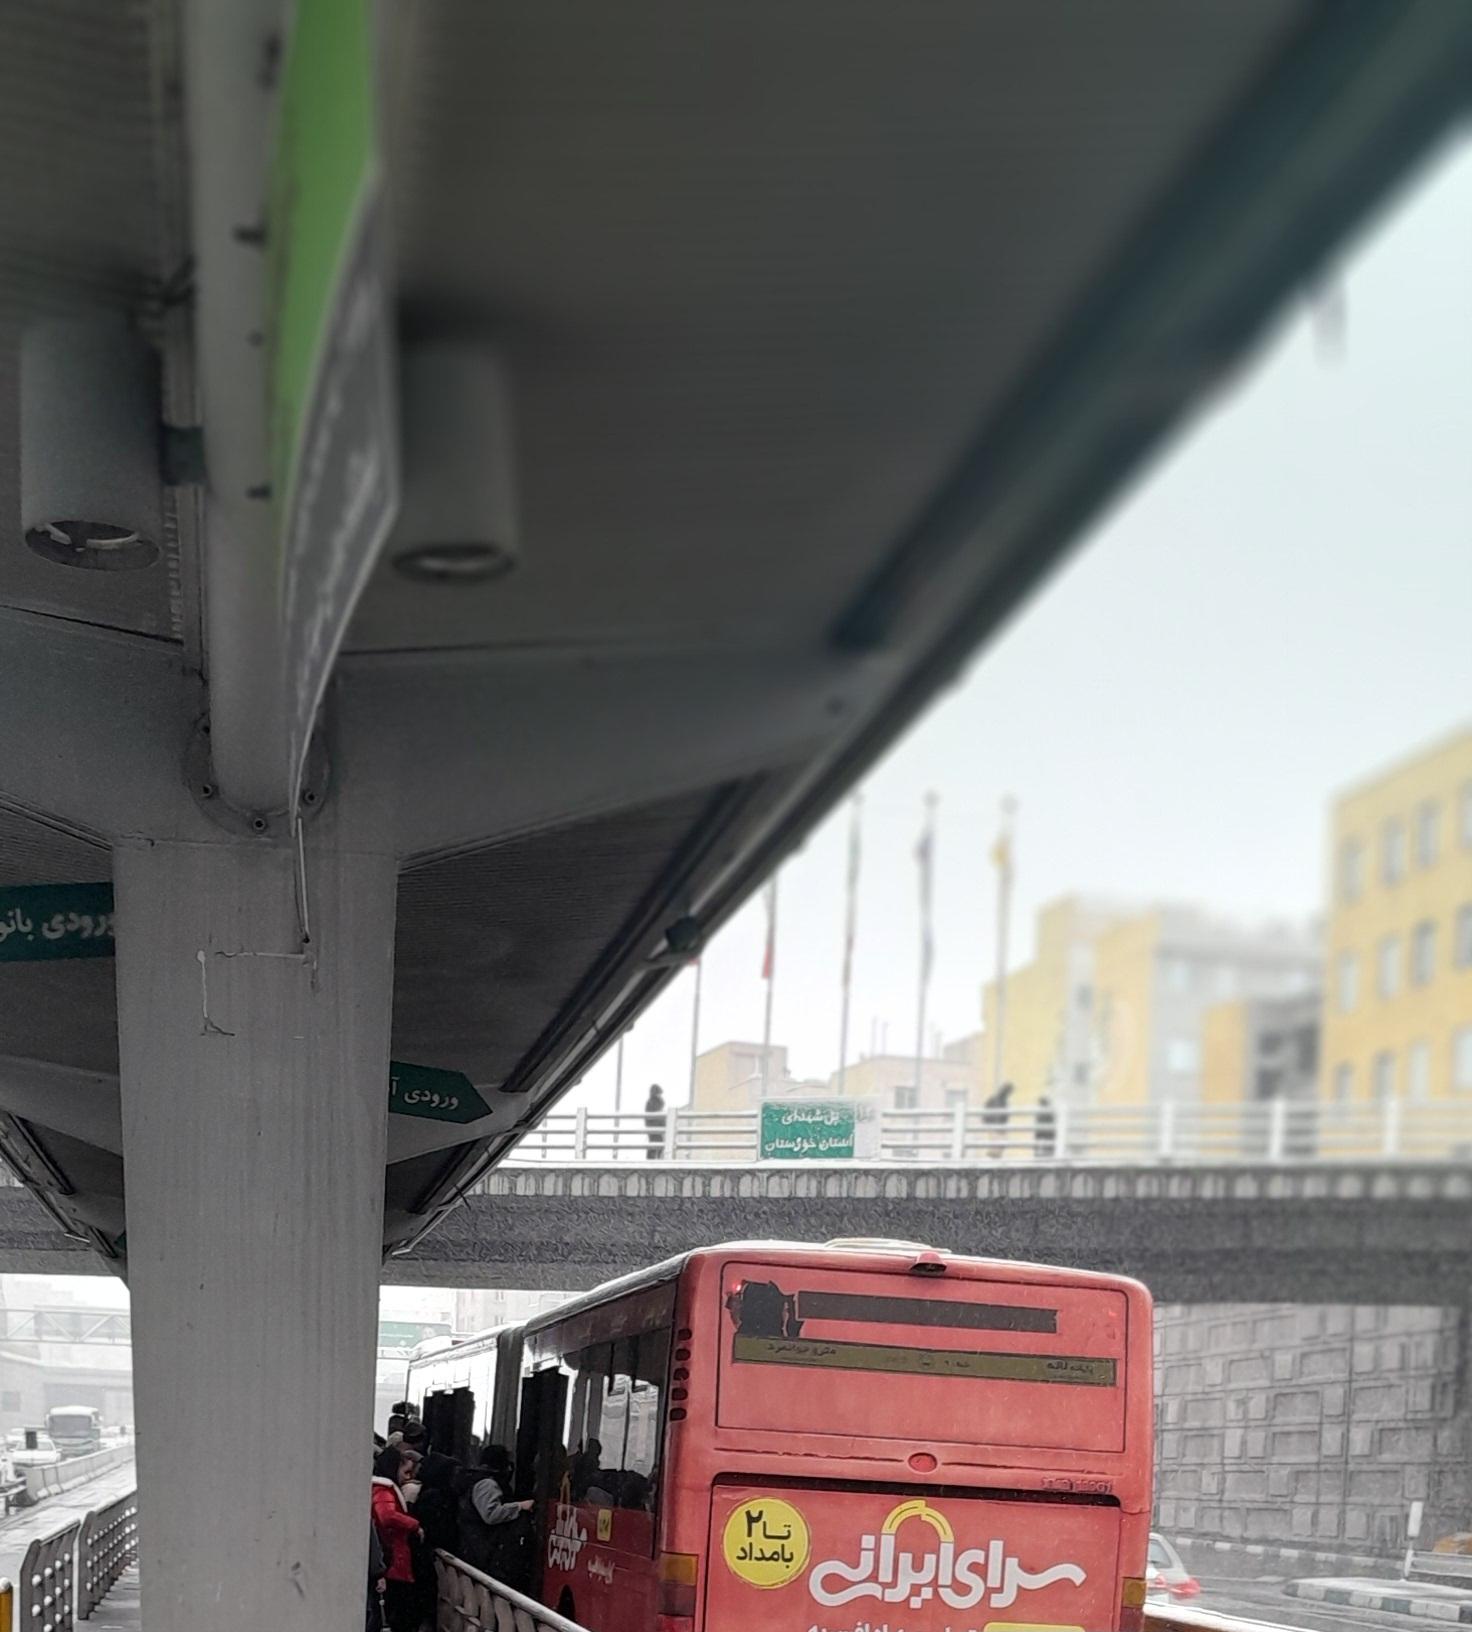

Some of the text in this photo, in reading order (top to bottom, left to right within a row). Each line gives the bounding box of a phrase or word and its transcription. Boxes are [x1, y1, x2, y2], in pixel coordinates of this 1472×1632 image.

[404, 1090, 459, 1110] ورودی
[781, 1109, 841, 1126] پل شهدای
[764, 1133, 853, 1156] استان خوزستان
[745, 1510, 791, 1540] تا ۲
[736, 1542, 794, 1569] بامداد
[808, 1534, 1087, 1610] سرای ایرانی
